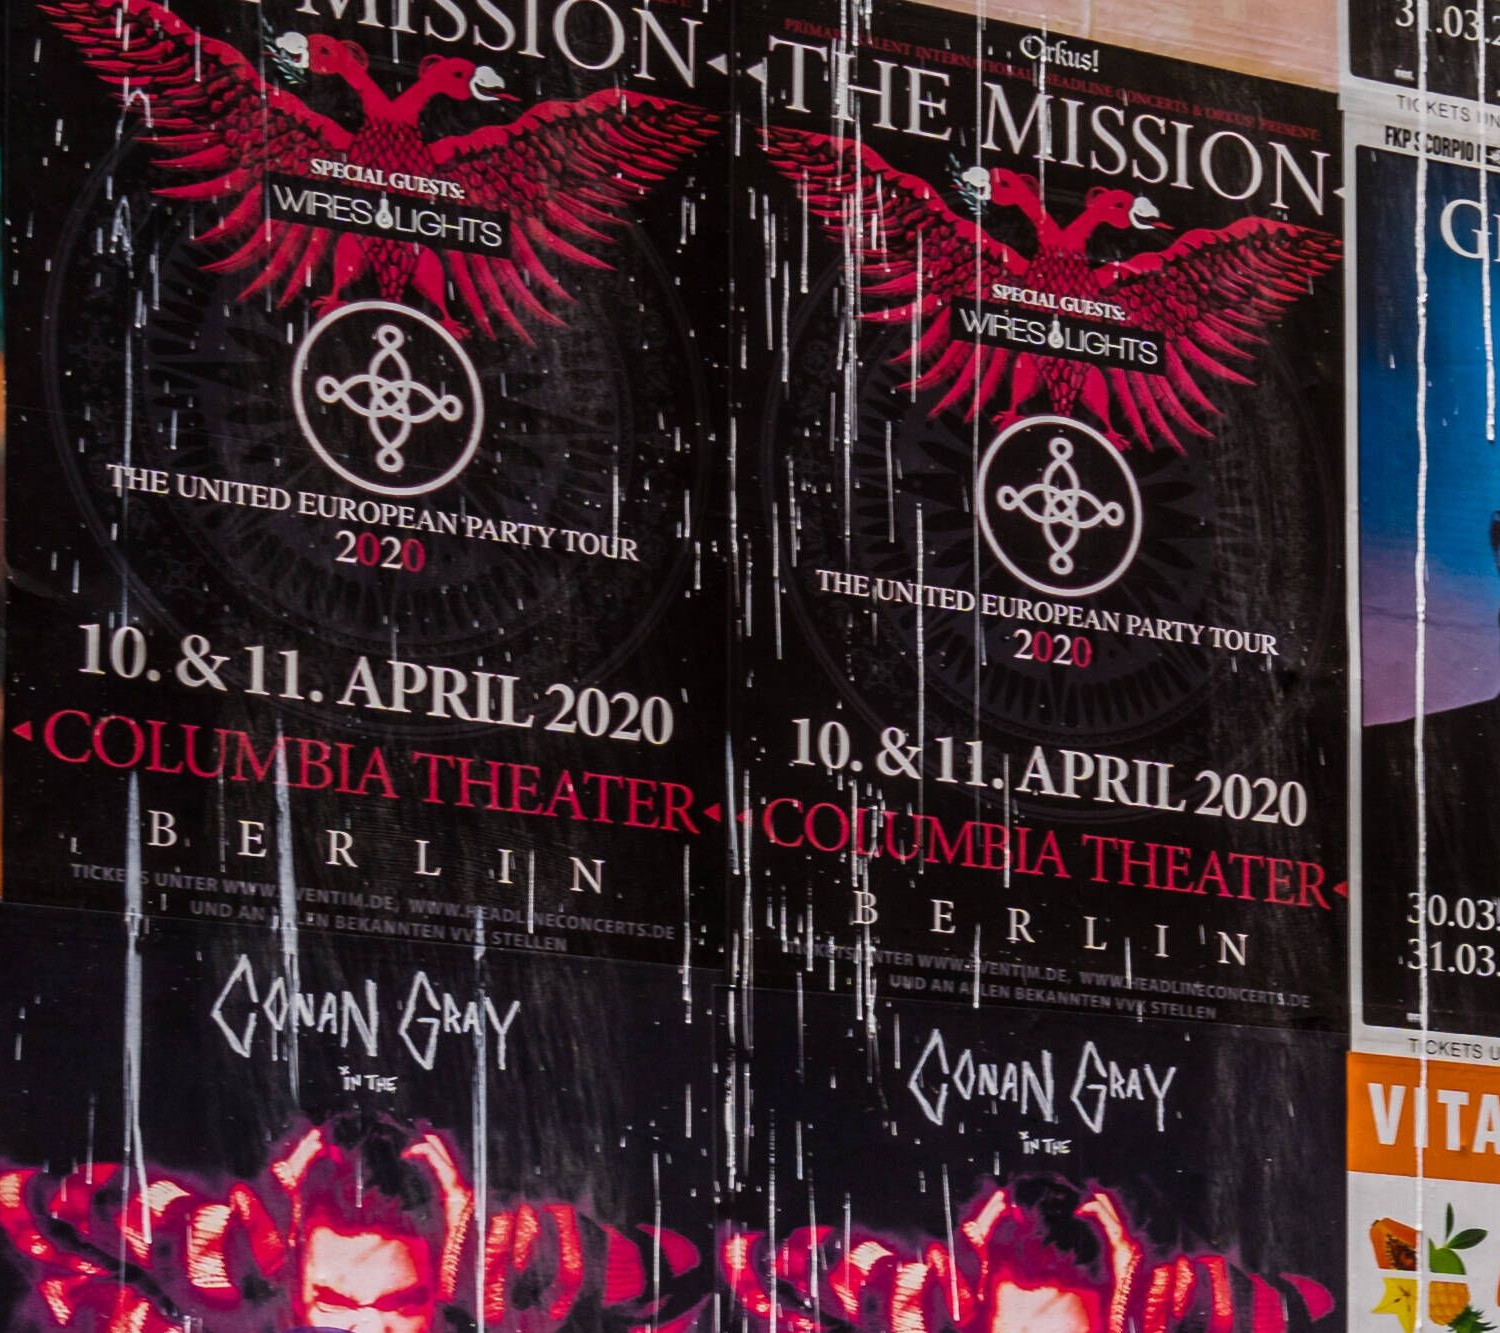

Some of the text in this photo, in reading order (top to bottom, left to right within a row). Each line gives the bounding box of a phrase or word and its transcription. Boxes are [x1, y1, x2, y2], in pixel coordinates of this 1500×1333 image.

[768, 35, 953, 142] THE
[982, 81, 1331, 216] MISSION
[1384, 125, 1413, 146] FKP
[1396, 94, 1470, 123] TICKETS
[310, 157, 467, 200] SPECIAL GUESTS:
[273, 185, 503, 248] WIRES LIGHTS
[960, 308, 1159, 366] WIRES LIGHTS
[992, 283, 1126, 322] SPECIAL GUESTS:
[106, 464, 640, 562] THE UNITED EUROPEAN PARTY TOUR
[335, 530, 426, 573] 2020
[815, 568, 1278, 656] THE UNITED EUROPEAN PARTY TOUR
[1013, 628, 1093, 668] 2020
[78, 622, 674, 746] 10. & 11. APRIL 2020
[43, 710, 700, 834] COLUMBIA THEATER
[791, 718, 1308, 828] 10. & 11. APRIL 2020
[148, 810, 606, 894] BERLIN
[762, 798, 1332, 910] COLUMBIA THEATER
[853, 890, 1249, 966] BERLIN
[210, 953, 520, 1071] CONAN GRAY
[1151, 999, 1216, 1020] STELLEN
[365, 1075, 397, 1093] THE
[908, 1028, 1177, 1134] CONAN GRAY
[1042, 1138, 1072, 1155] THE
